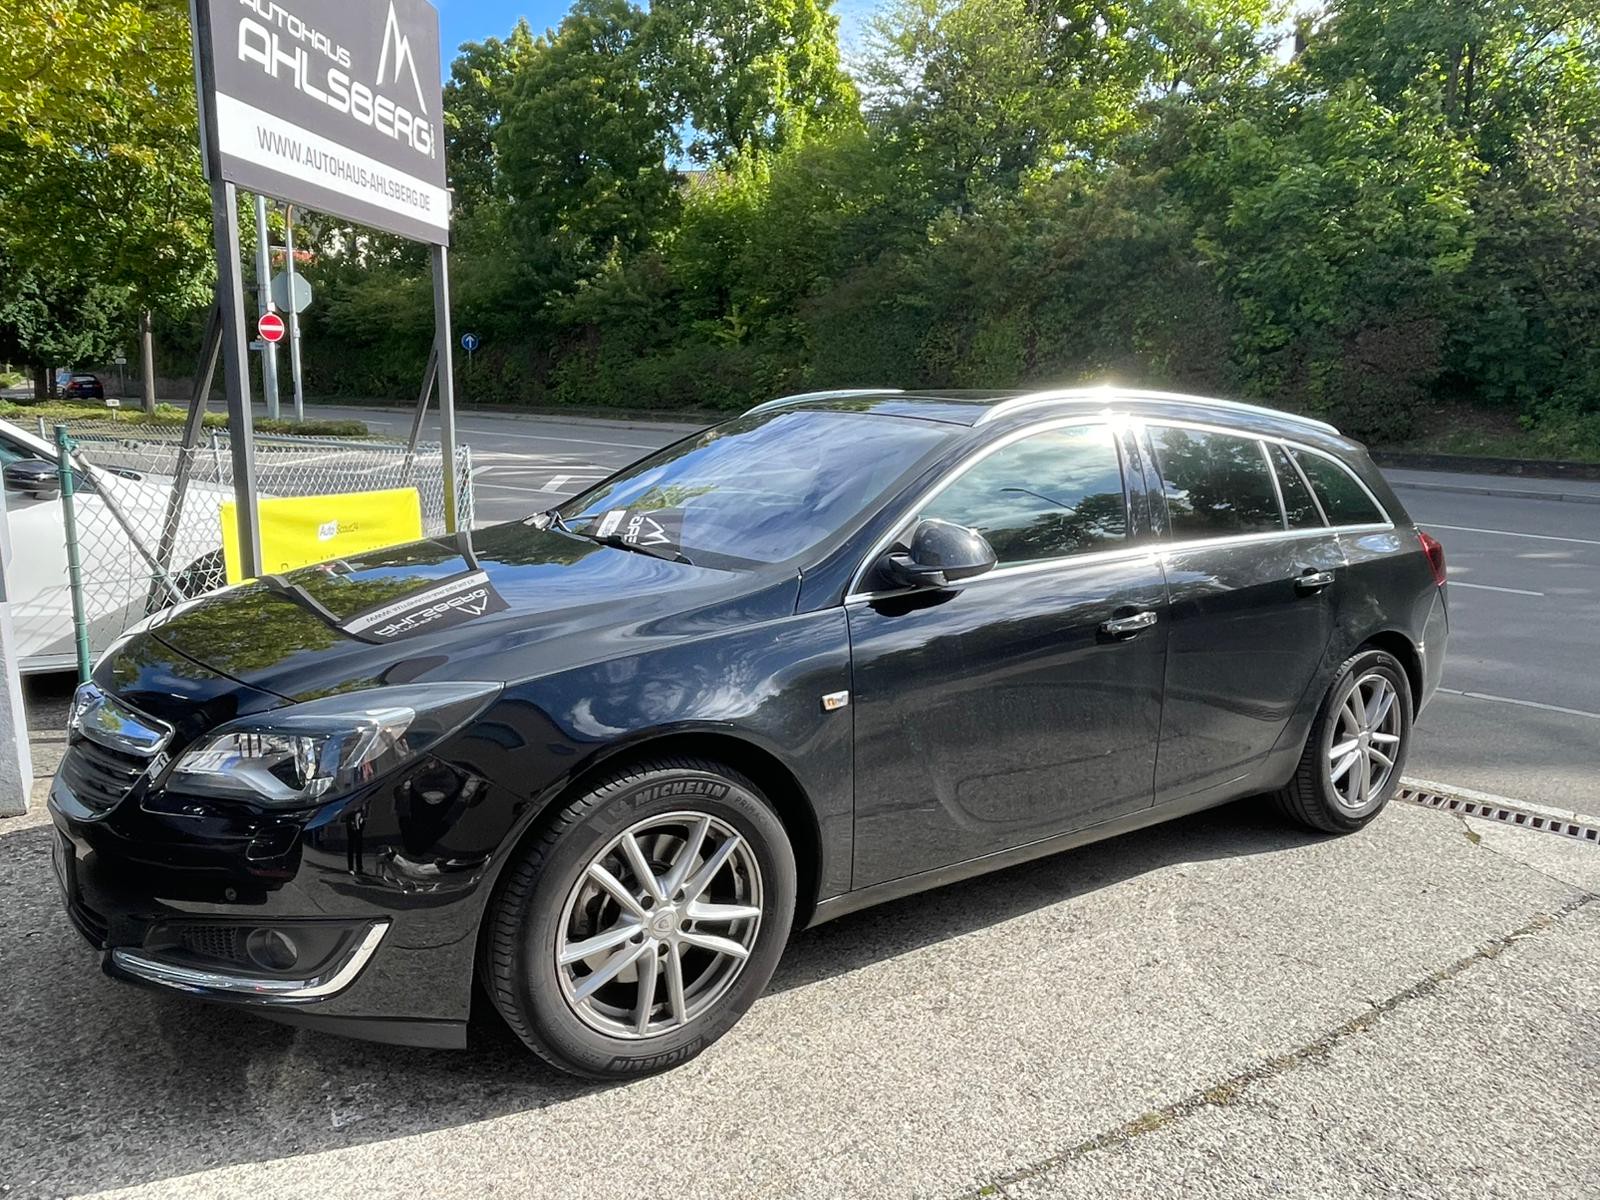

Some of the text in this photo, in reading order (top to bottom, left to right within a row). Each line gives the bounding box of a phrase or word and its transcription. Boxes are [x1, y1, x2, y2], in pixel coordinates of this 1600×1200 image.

[238, 17, 430, 155] AHLSBERG
[257, 125, 431, 212] WWW.AUTOHAUS-AHLSBERG.DE
[635, 781, 726, 807] MICHELIN
